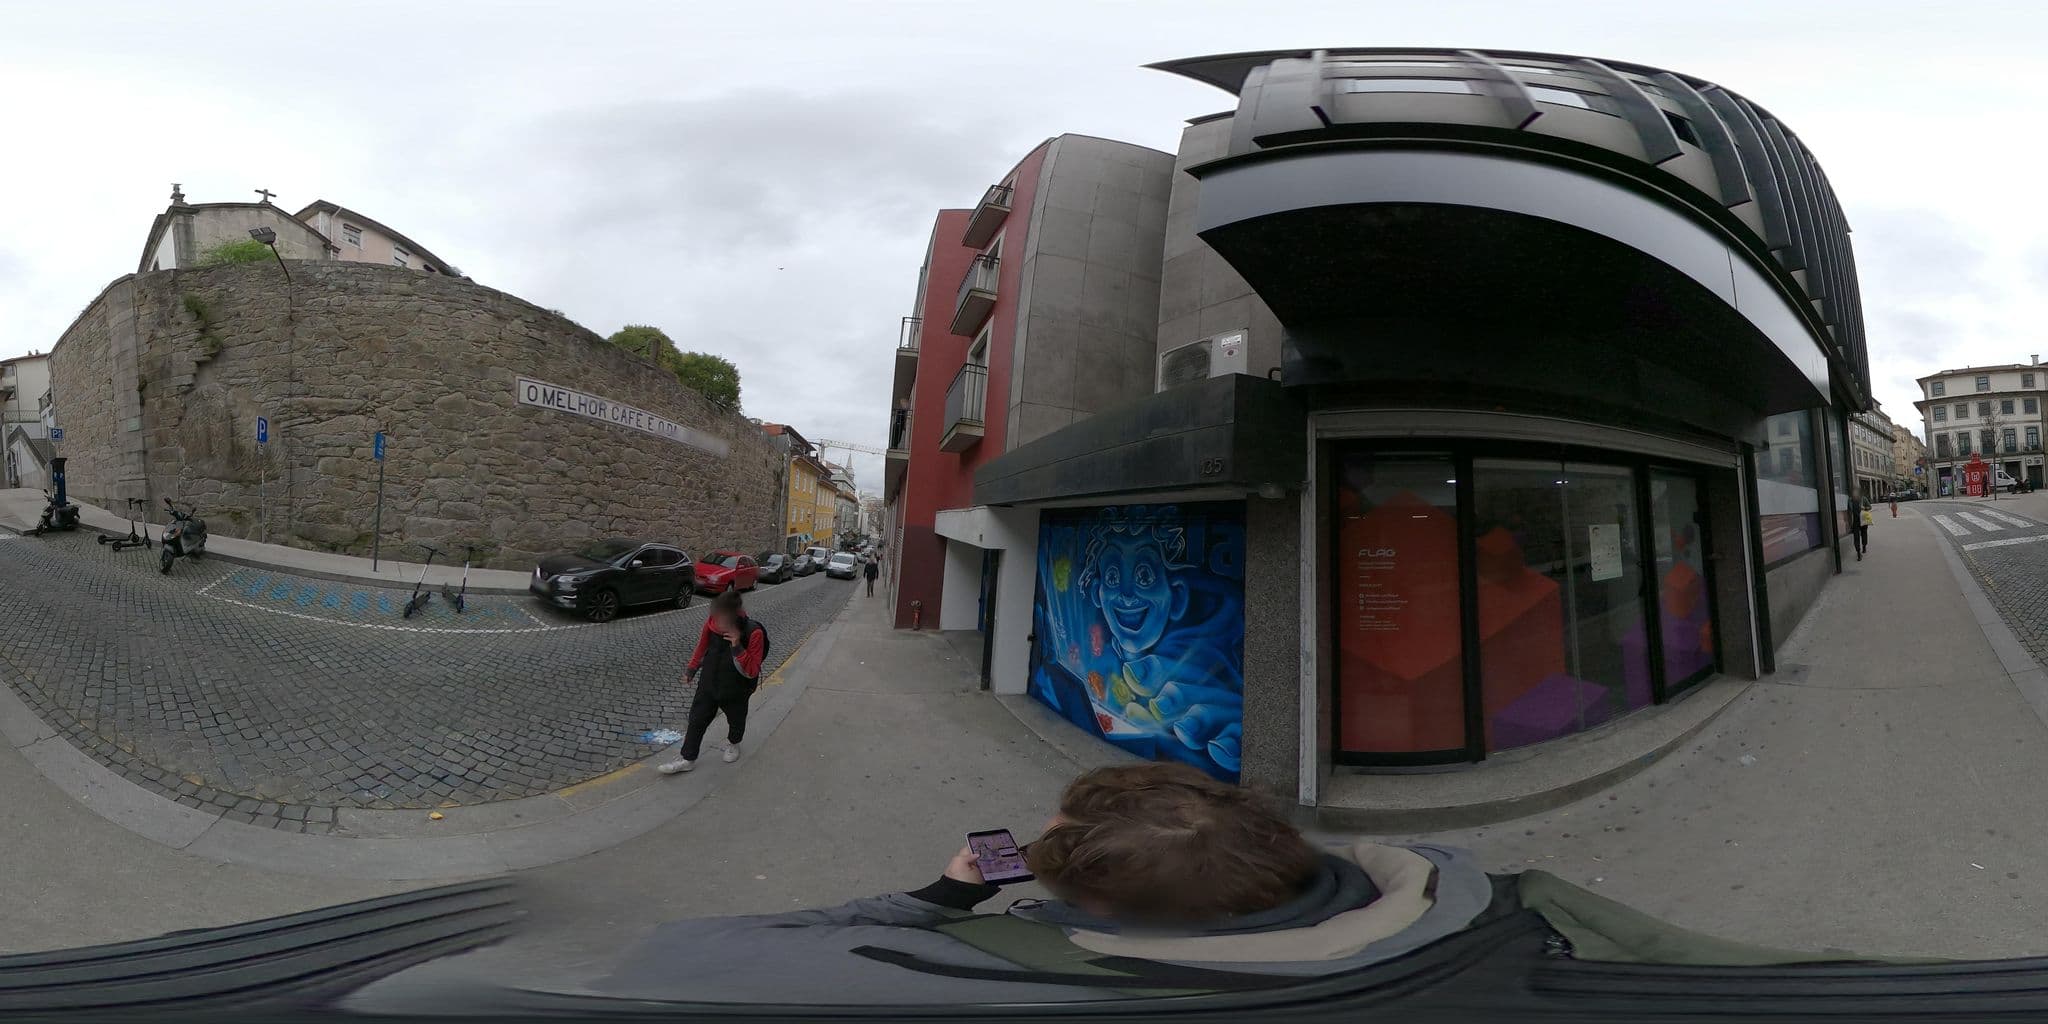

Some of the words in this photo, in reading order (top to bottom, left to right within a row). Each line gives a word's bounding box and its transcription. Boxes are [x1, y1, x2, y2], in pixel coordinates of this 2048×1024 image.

[527, 385, 538, 402] O
[543, 387, 607, 419] MELHOR
[259, 420, 266, 440] P
[1358, 548, 1396, 558] FLAG
